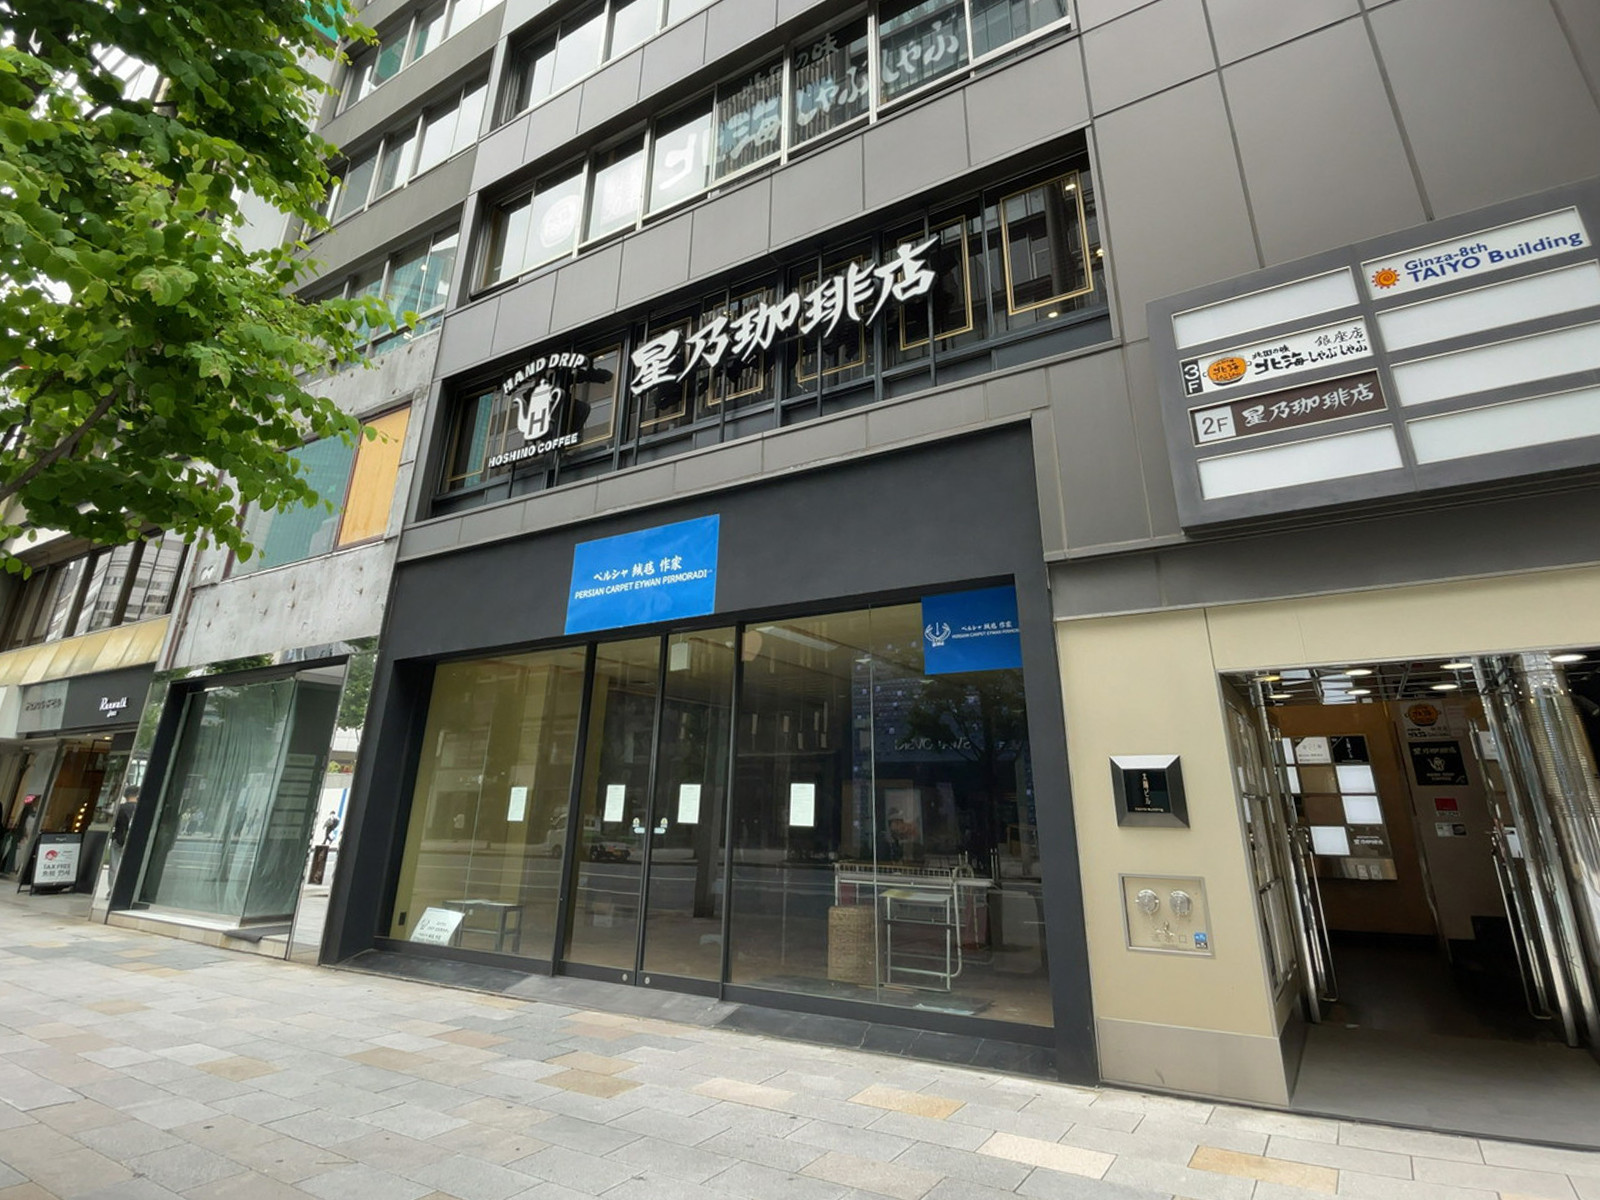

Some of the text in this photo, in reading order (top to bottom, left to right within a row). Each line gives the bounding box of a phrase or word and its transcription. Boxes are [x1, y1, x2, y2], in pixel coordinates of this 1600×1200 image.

[1404, 243, 1488, 271] Ginza-8th
[1407, 232, 1583, 283] TAIYO Building
[630, 236, 939, 396] 星乃珈琲店
[502, 352, 585, 394] HAND DRIP
[1202, 382, 1376, 436] 2F 星乃珈琲店
[488, 432, 578, 467] HOSHINO COFFEE
[574, 586, 604, 600] PERSIAN
[605, 581, 634, 595] CARPET
[634, 577, 661, 590] EYWAN
[593, 568, 629, 581] ペルシャ
